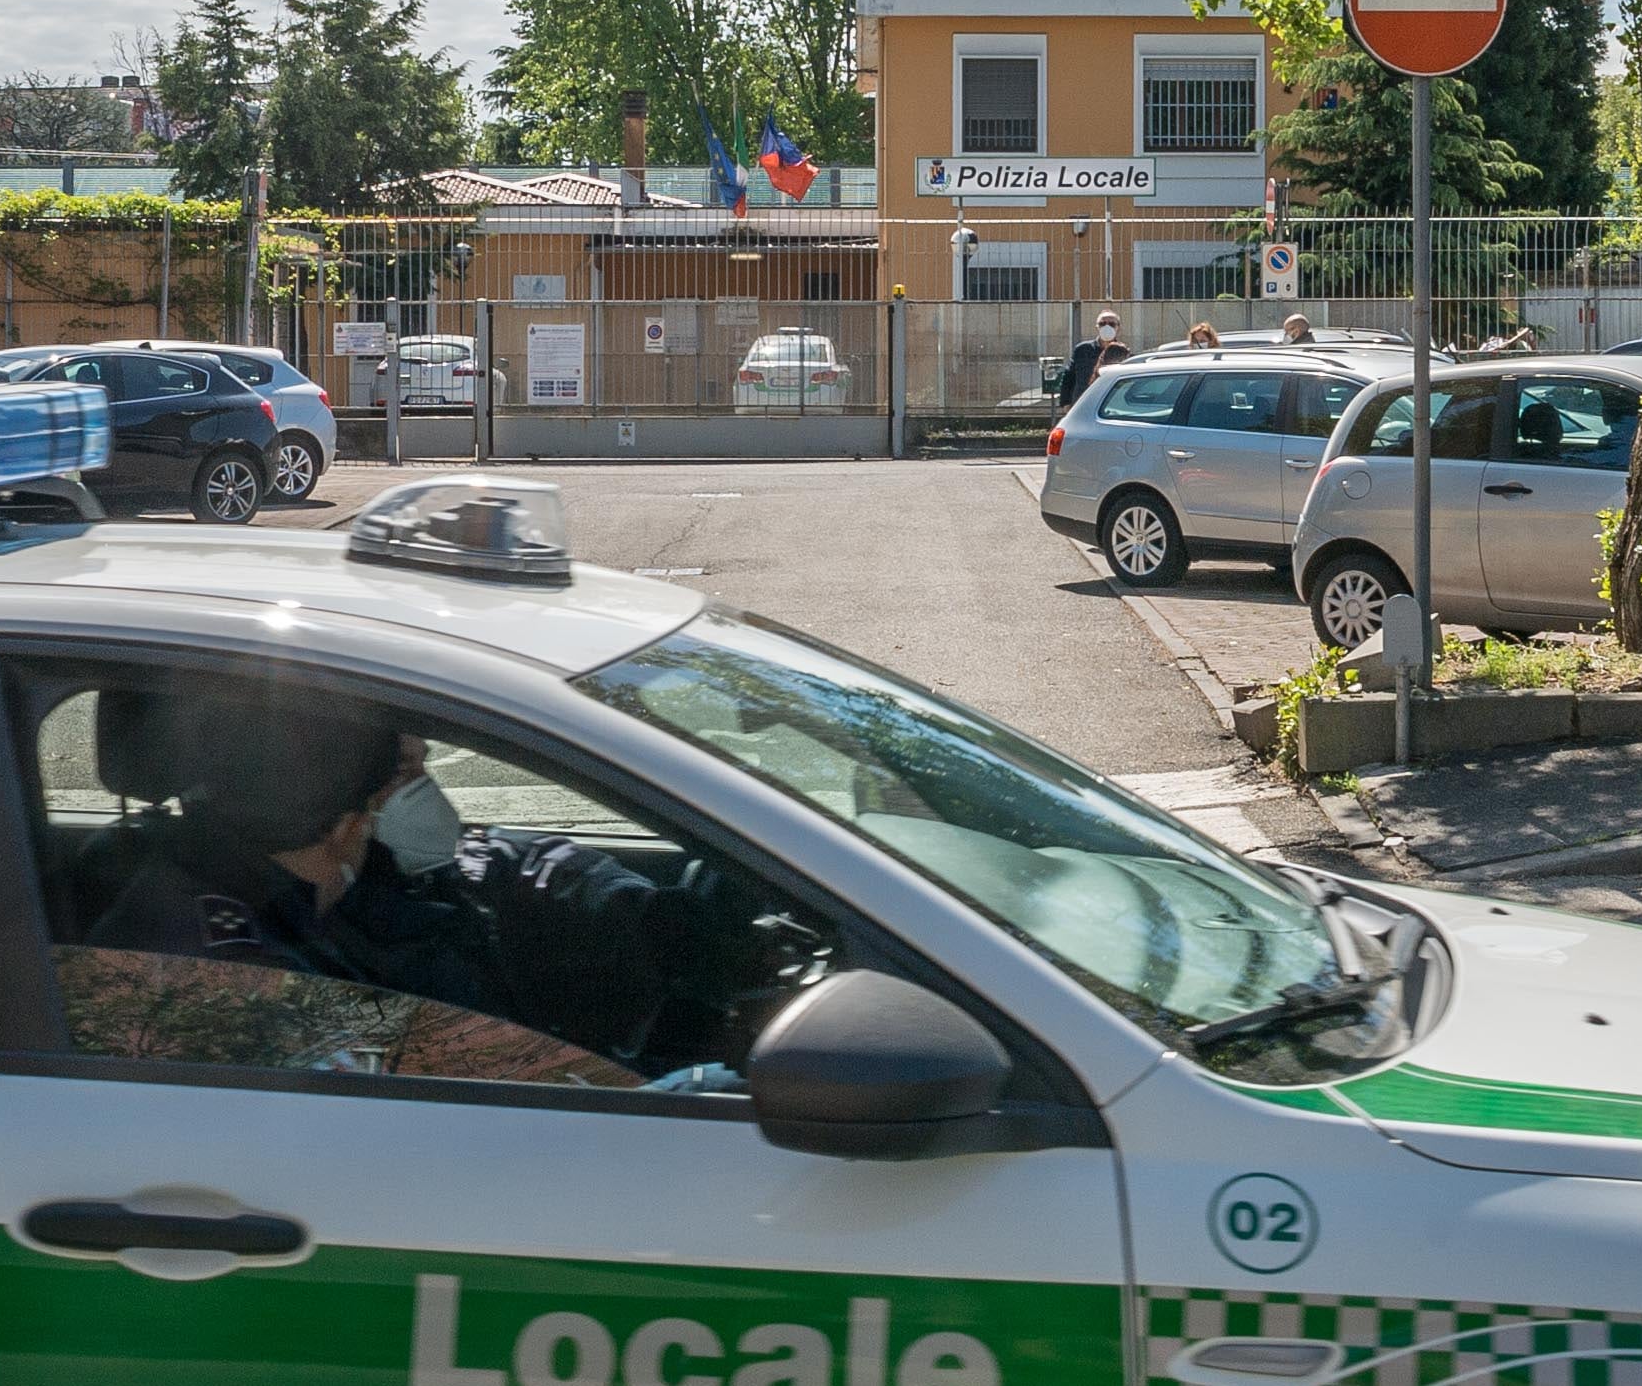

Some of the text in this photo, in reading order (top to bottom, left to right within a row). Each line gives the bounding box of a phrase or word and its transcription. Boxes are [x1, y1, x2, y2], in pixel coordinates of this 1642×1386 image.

[957, 165, 1149, 189] Polizia Locale
[1227, 1200, 1302, 1243] 02
[406, 1271, 1004, 1386] Locale
